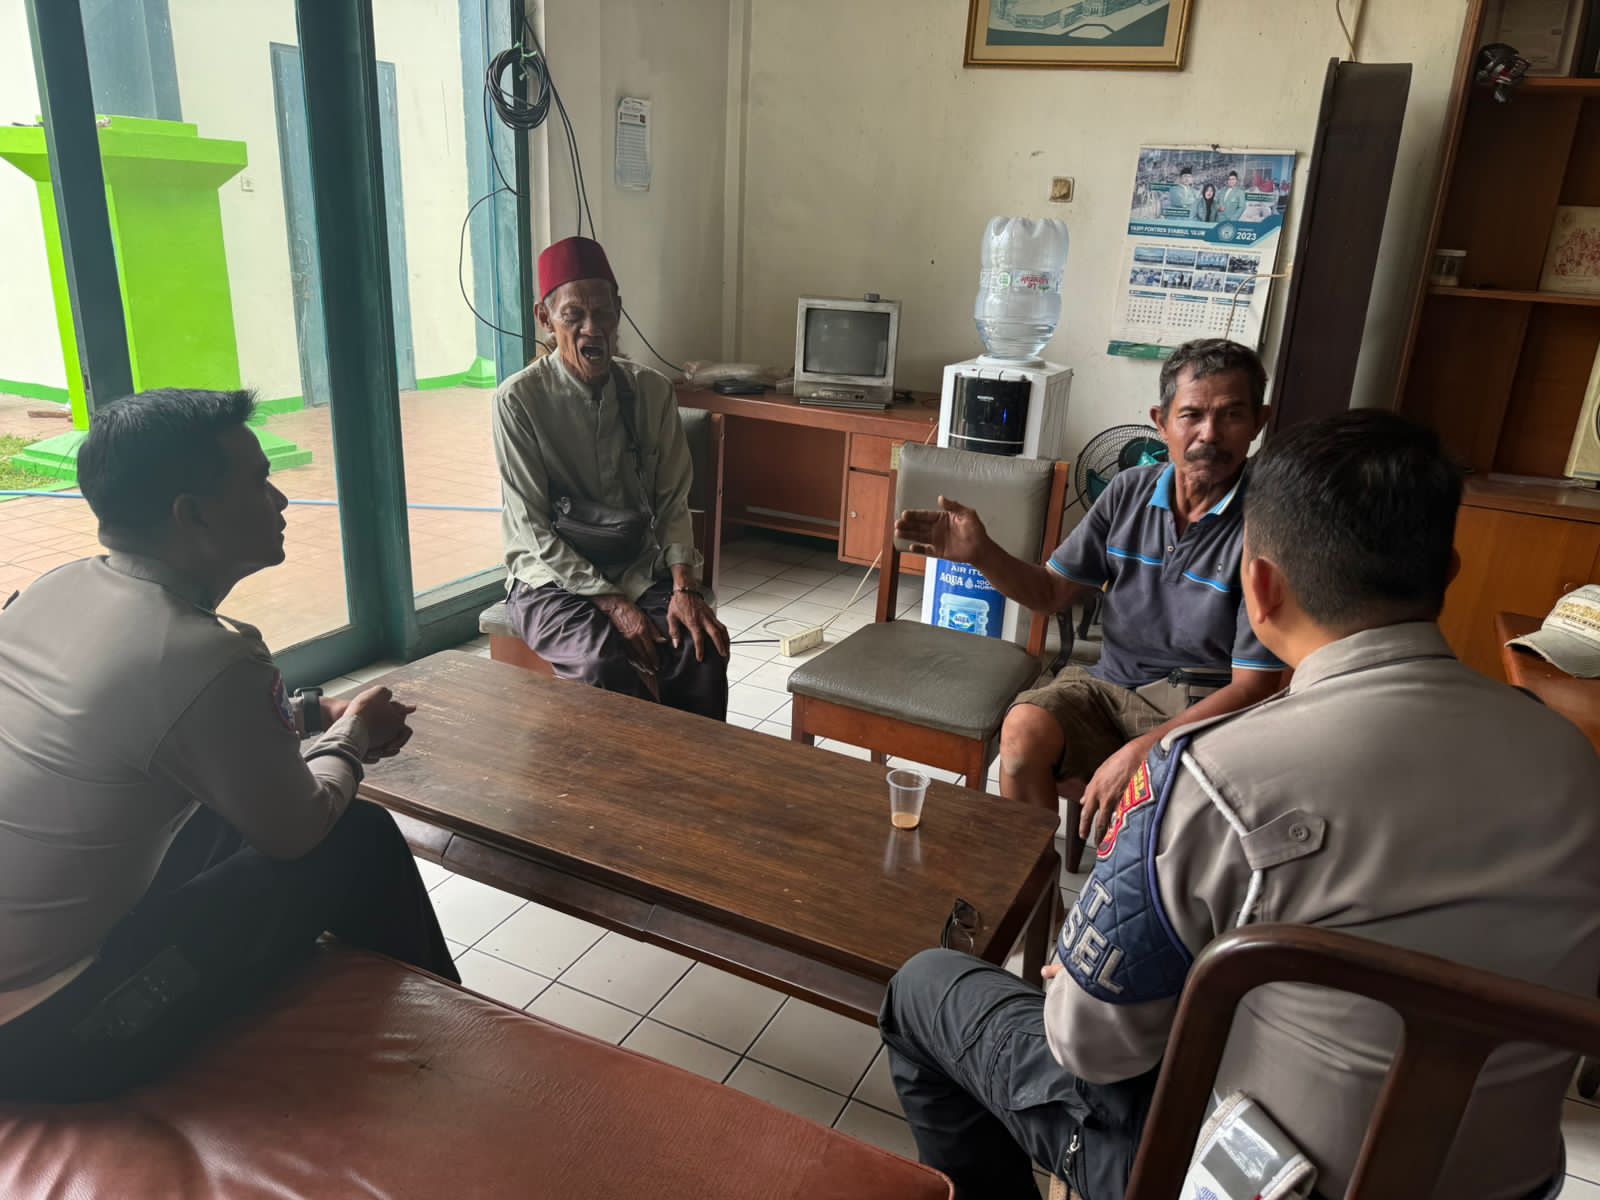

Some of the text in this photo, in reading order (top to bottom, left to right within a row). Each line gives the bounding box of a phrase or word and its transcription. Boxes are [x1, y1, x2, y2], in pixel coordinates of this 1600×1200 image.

[1236, 232, 1257, 241] 2023
[951, 565, 966, 574] AIR
[940, 572, 964, 586] AQUA
